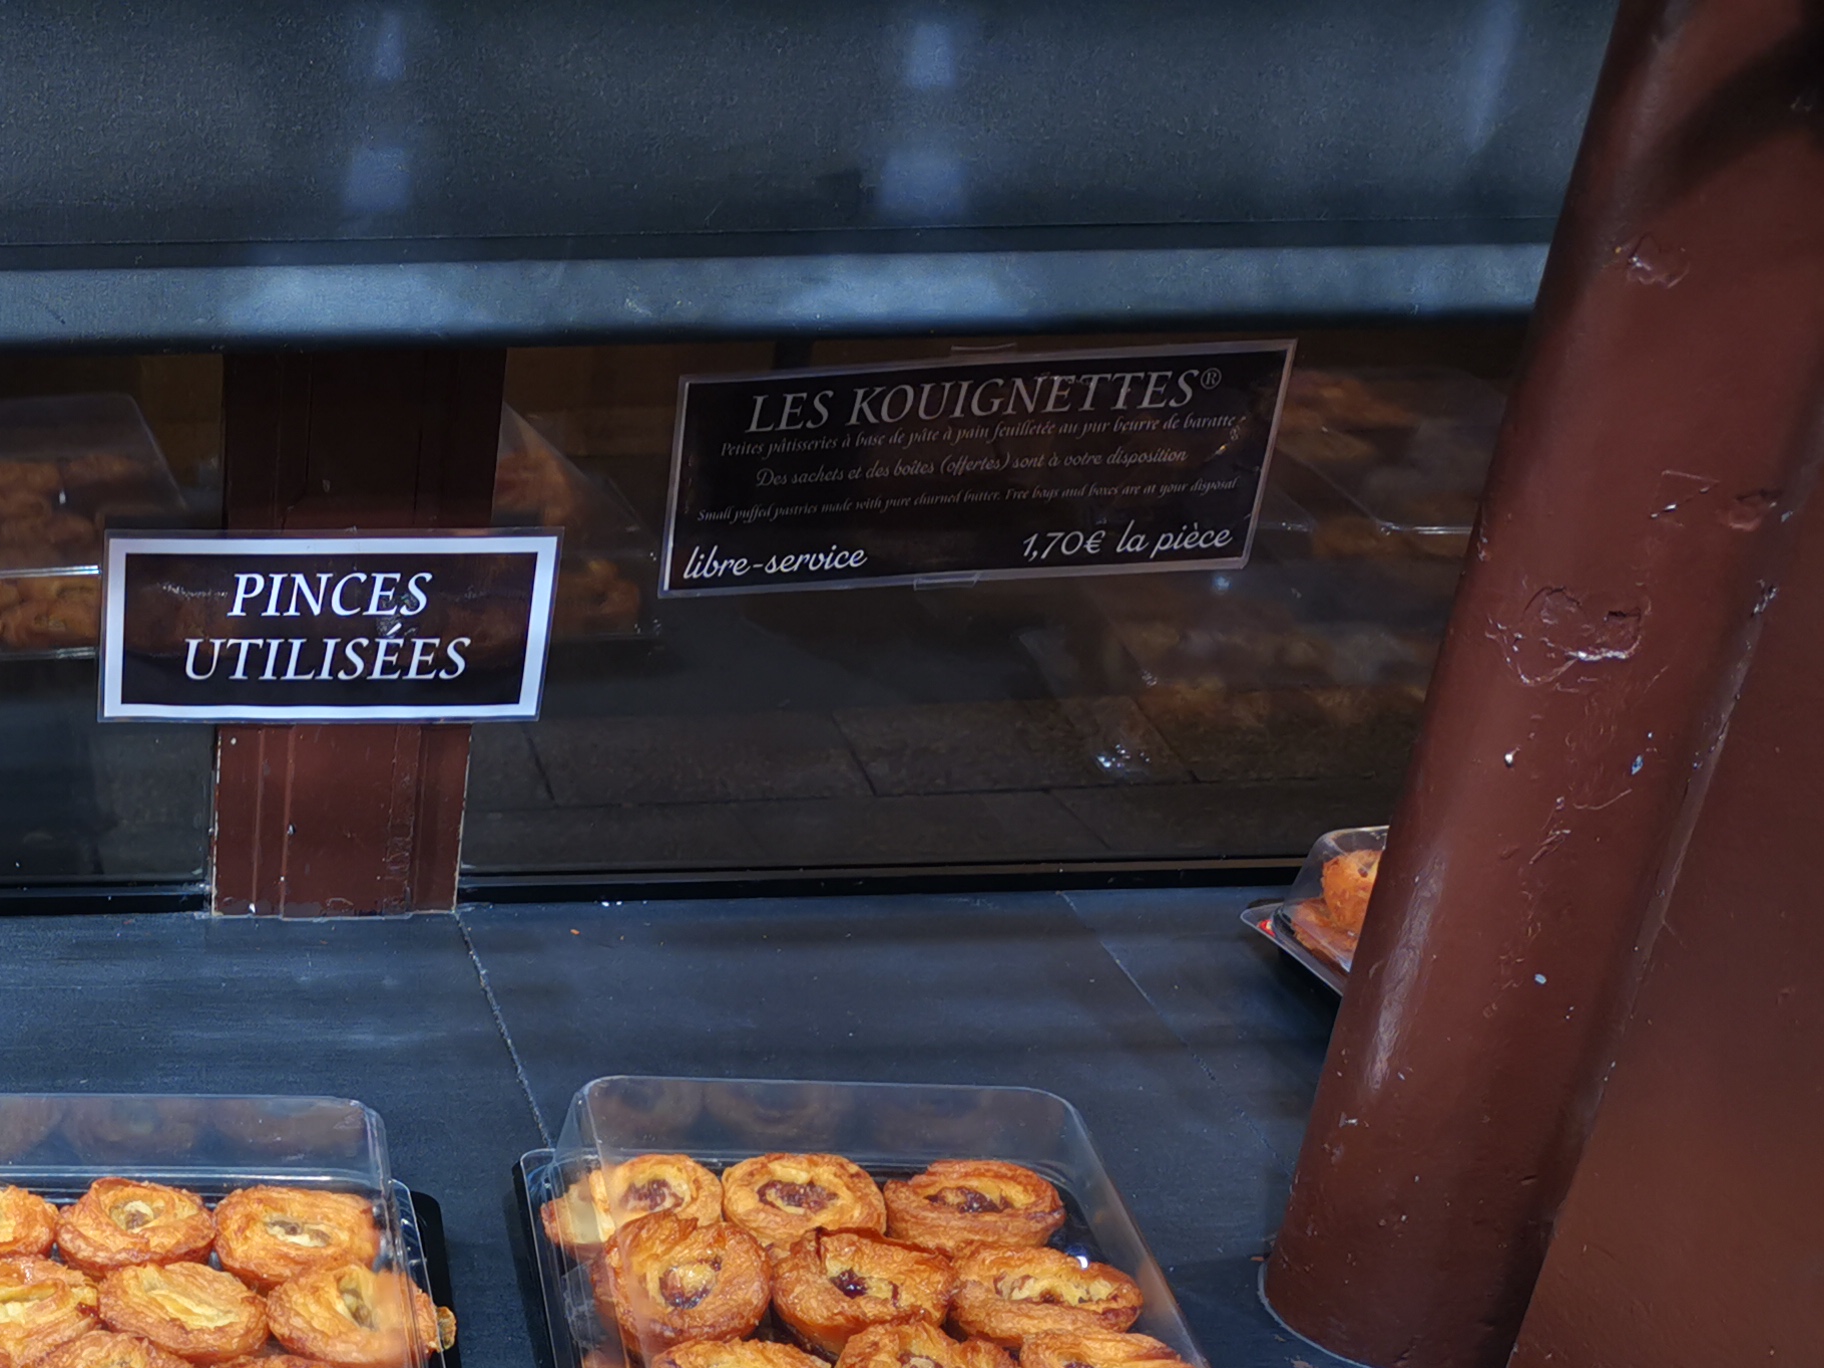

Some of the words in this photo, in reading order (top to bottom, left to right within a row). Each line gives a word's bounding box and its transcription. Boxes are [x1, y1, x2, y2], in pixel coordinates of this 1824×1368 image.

[745, 389, 833, 432] LES
[720, 441, 763, 457] Petites
[763, 435, 837, 459] pâtisseries
[842, 434, 851, 448] à
[855, 432, 883, 447] base
[889, 428, 905, 446] de
[905, 428, 938, 449] pâte
[942, 425, 952, 441] à
[947, 426, 988, 446] pain
[986, 417, 1056, 444] feuilletée
[1059, 422, 1076, 434] au
[1076, 421, 1110, 439] pur
[1113, 415, 1159, 433] beurre
[1163, 413, 1179, 430] de
[1183, 413, 1236, 429] baratte
[756, 468, 786, 487] Des
[791, 464, 844, 484] sachets
[848, 465, 863, 480] et
[867, 460, 889, 478] des
[894, 457, 934, 476] boîtes
[940, 453, 1011, 477] (offertes)
[1012, 452, 1044, 469] sont
[1048, 449, 1061, 466] à
[1065, 450, 1102, 466] votre
[1106, 446, 1188, 467] disposition
[697, 507, 731, 521] Small
[730, 506, 771, 524] puffed
[770, 502, 817, 521] pastries
[821, 499, 851, 513] made
[855, 496, 881, 510] with
[883, 496, 911, 513] pure
[913, 491, 960, 507] churned
[1005, 487, 1028, 500] Free
[1031, 485, 1059, 501] bags
[1062, 483, 1085, 497] and
[1088, 481, 1118, 496] boxes
[1122, 483, 1140, 496] are
[1143, 482, 1156, 494] at
[1160, 480, 1188, 497] your
[1190, 476, 1238, 496] disposal
[683, 545, 868, 579] libre-service
[1023, 530, 1106, 562] 1,70€
[1116, 519, 1149, 553] la
[1150, 522, 1234, 558] pièce
[227, 572, 432, 617] PINCES
[184, 622, 471, 681] UTILISÉES
